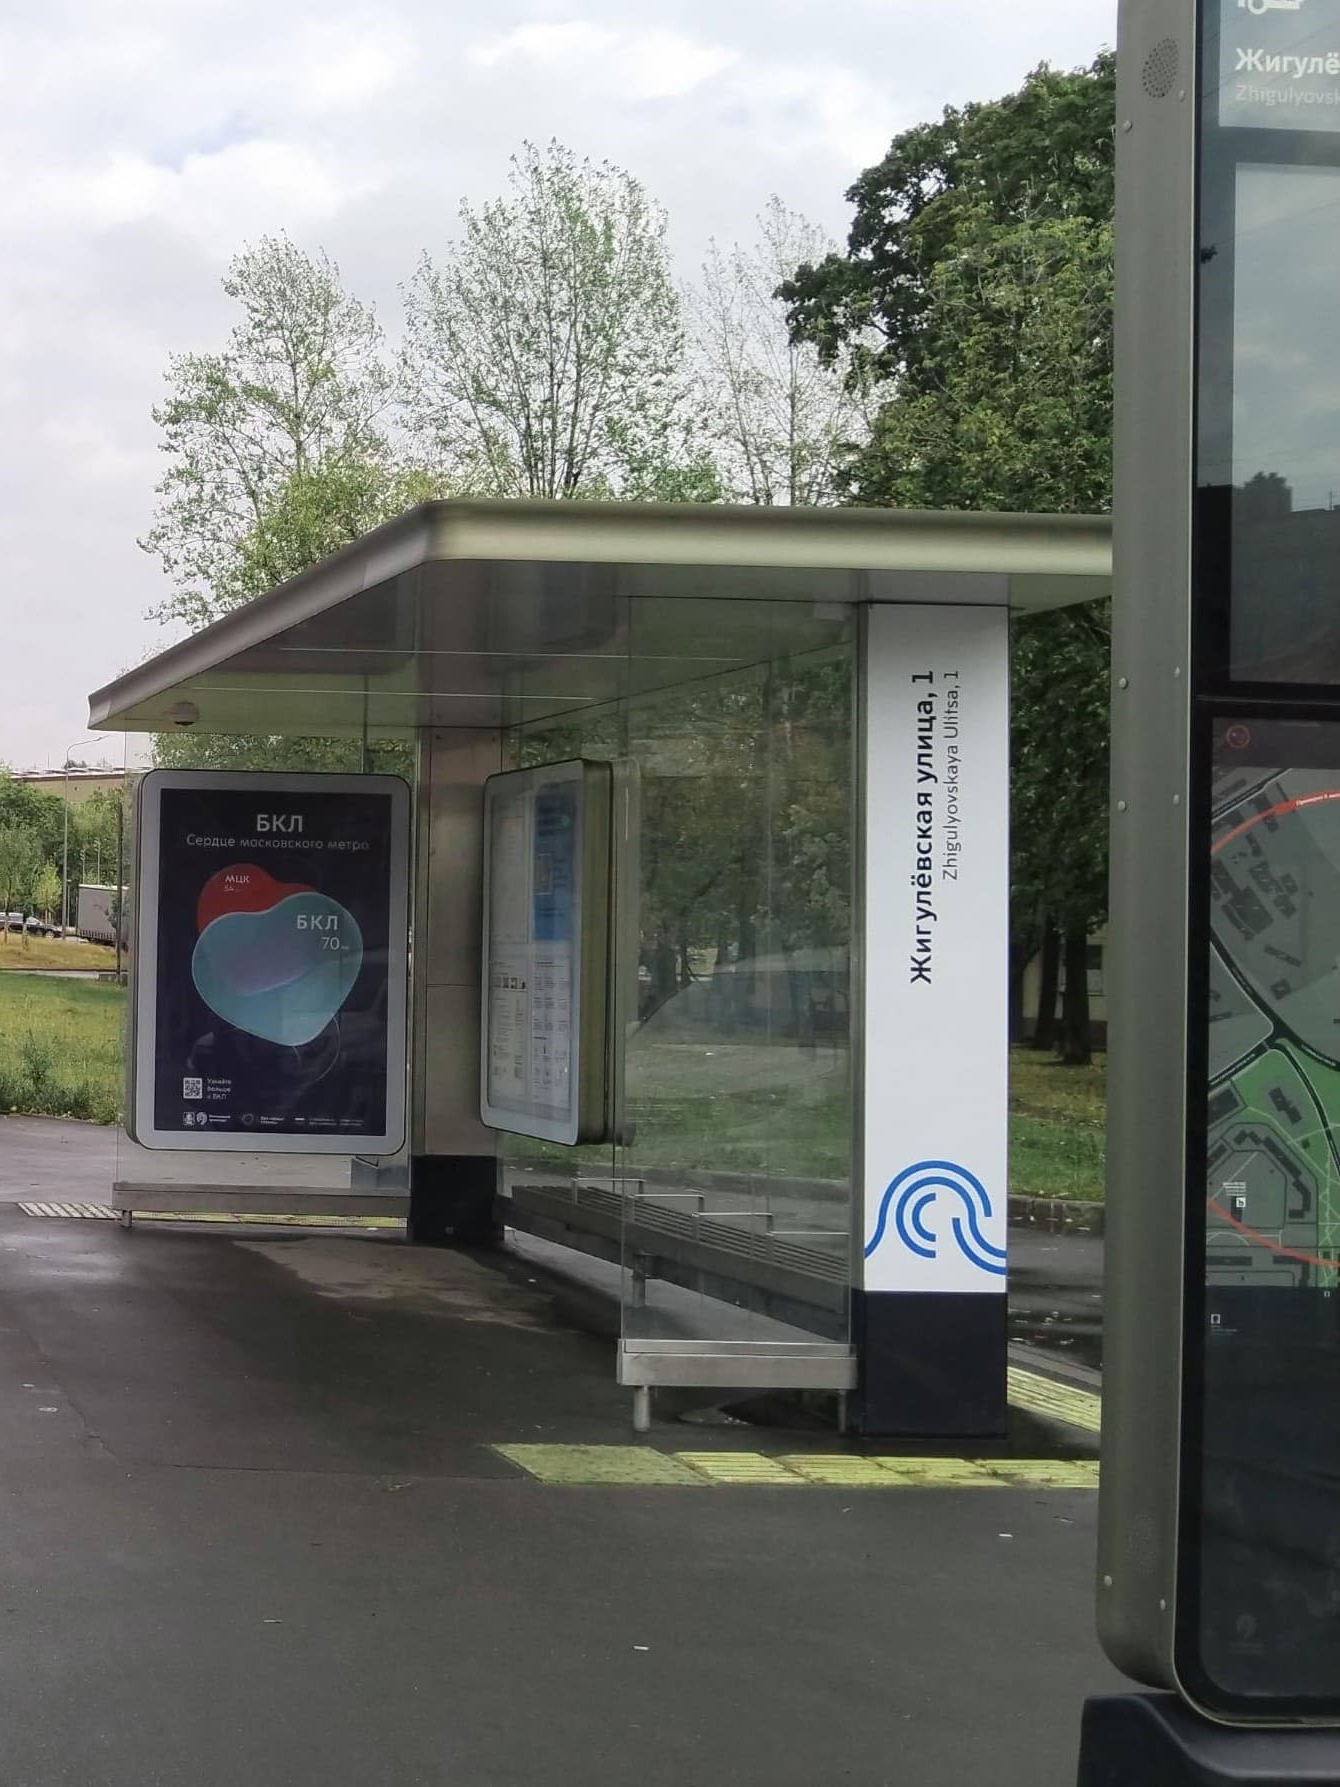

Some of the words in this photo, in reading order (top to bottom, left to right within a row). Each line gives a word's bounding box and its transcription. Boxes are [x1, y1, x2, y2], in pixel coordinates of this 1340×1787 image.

[1235, 47, 1340, 79] Жигулё
[911, 671, 933, 684] 1
[943, 671, 959, 679] 1
[943, 685, 961, 738] Ulitsa,
[917, 692, 938, 783] улица,
[943, 745, 961, 880] Zhigulyovskaya
[256, 814, 303, 832] БКЛ
[186, 834, 236, 847] Сердце
[240, 838, 324, 849] московского
[327, 840, 369, 851] метро
[224, 874, 250, 885] МЦК
[910, 792, 937, 984] Жигулёвская
[296, 914, 339, 931] БКЛ
[321, 935, 340, 951] 70
